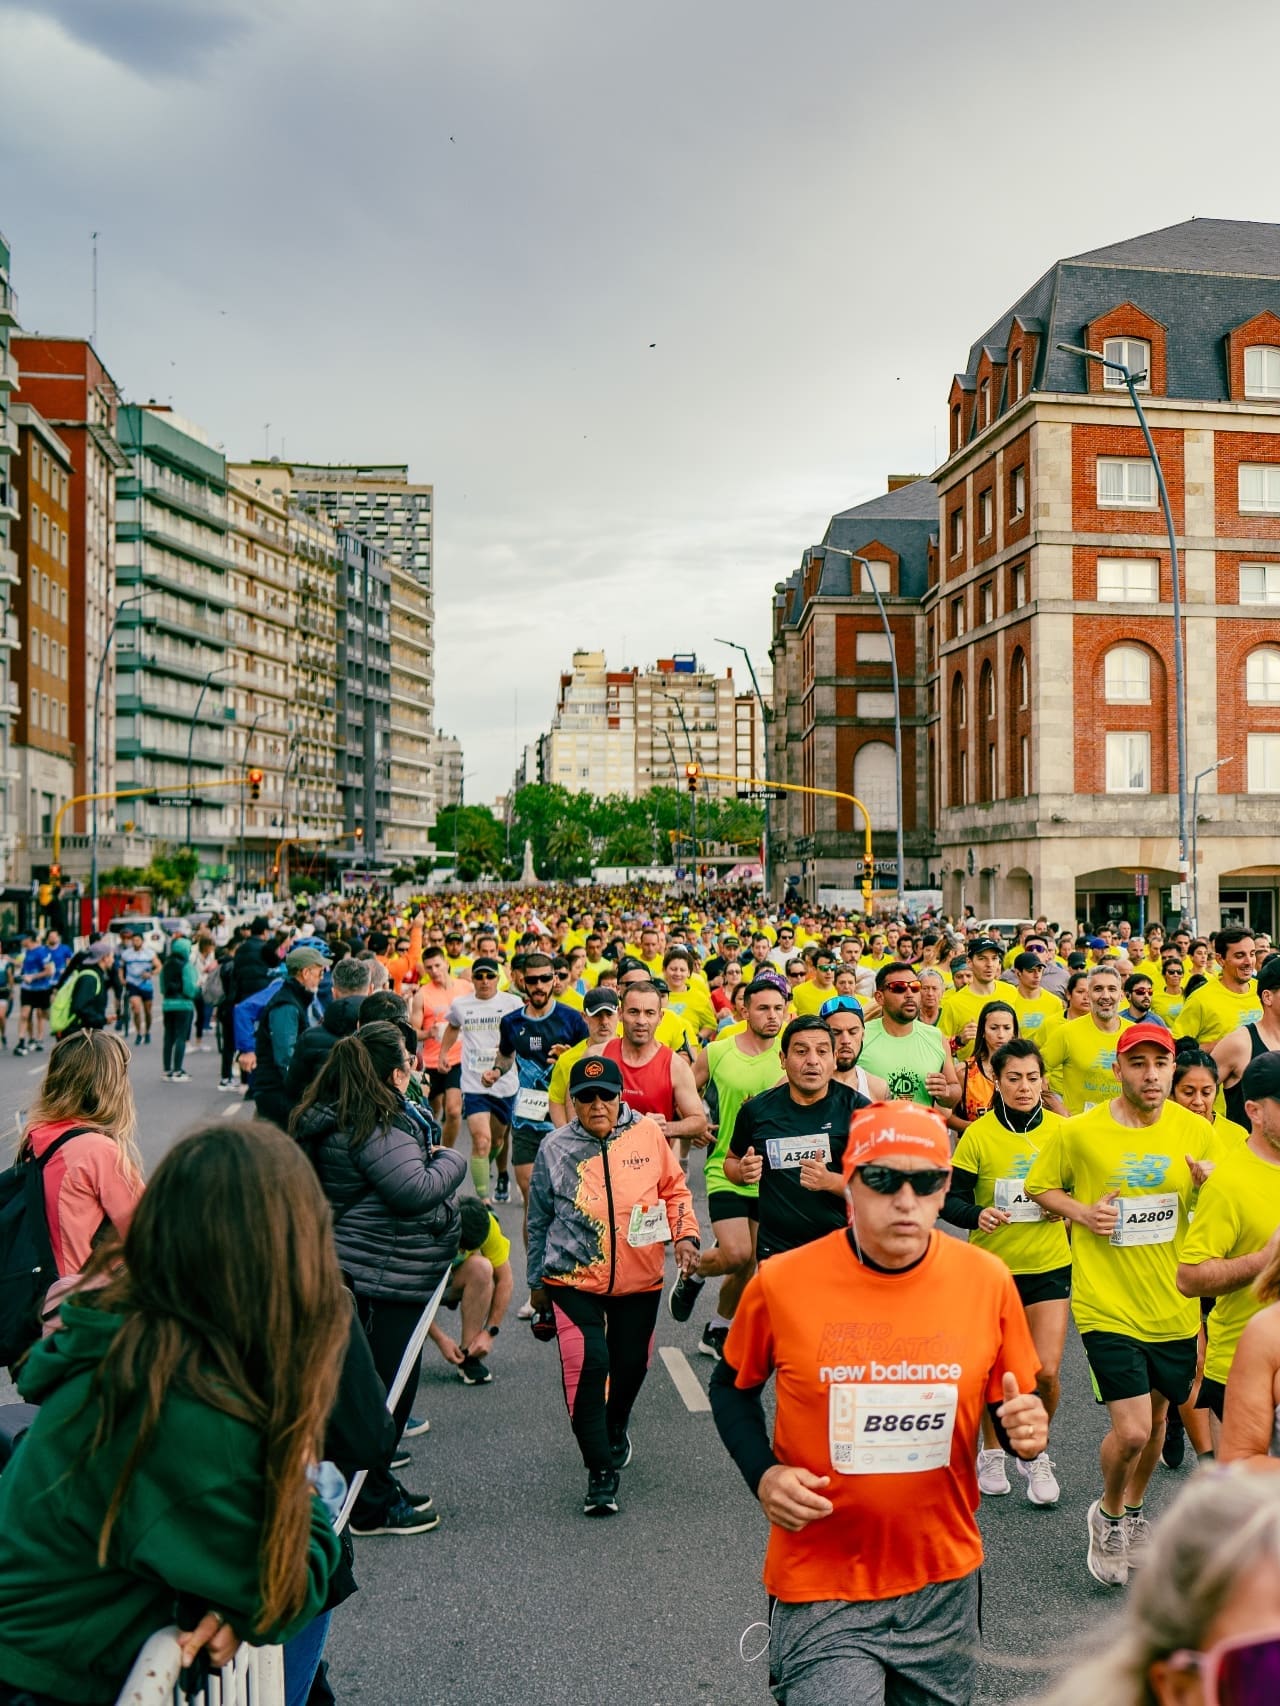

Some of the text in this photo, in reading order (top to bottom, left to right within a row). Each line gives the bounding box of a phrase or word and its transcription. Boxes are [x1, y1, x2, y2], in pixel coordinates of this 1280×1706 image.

[1126, 1209, 1174, 1225] A2809
[823, 1322, 892, 1340] MEDIO
[820, 1360, 962, 1382] new balance
[836, 1388, 851, 1423] B
[864, 1412, 946, 1432] B8665
